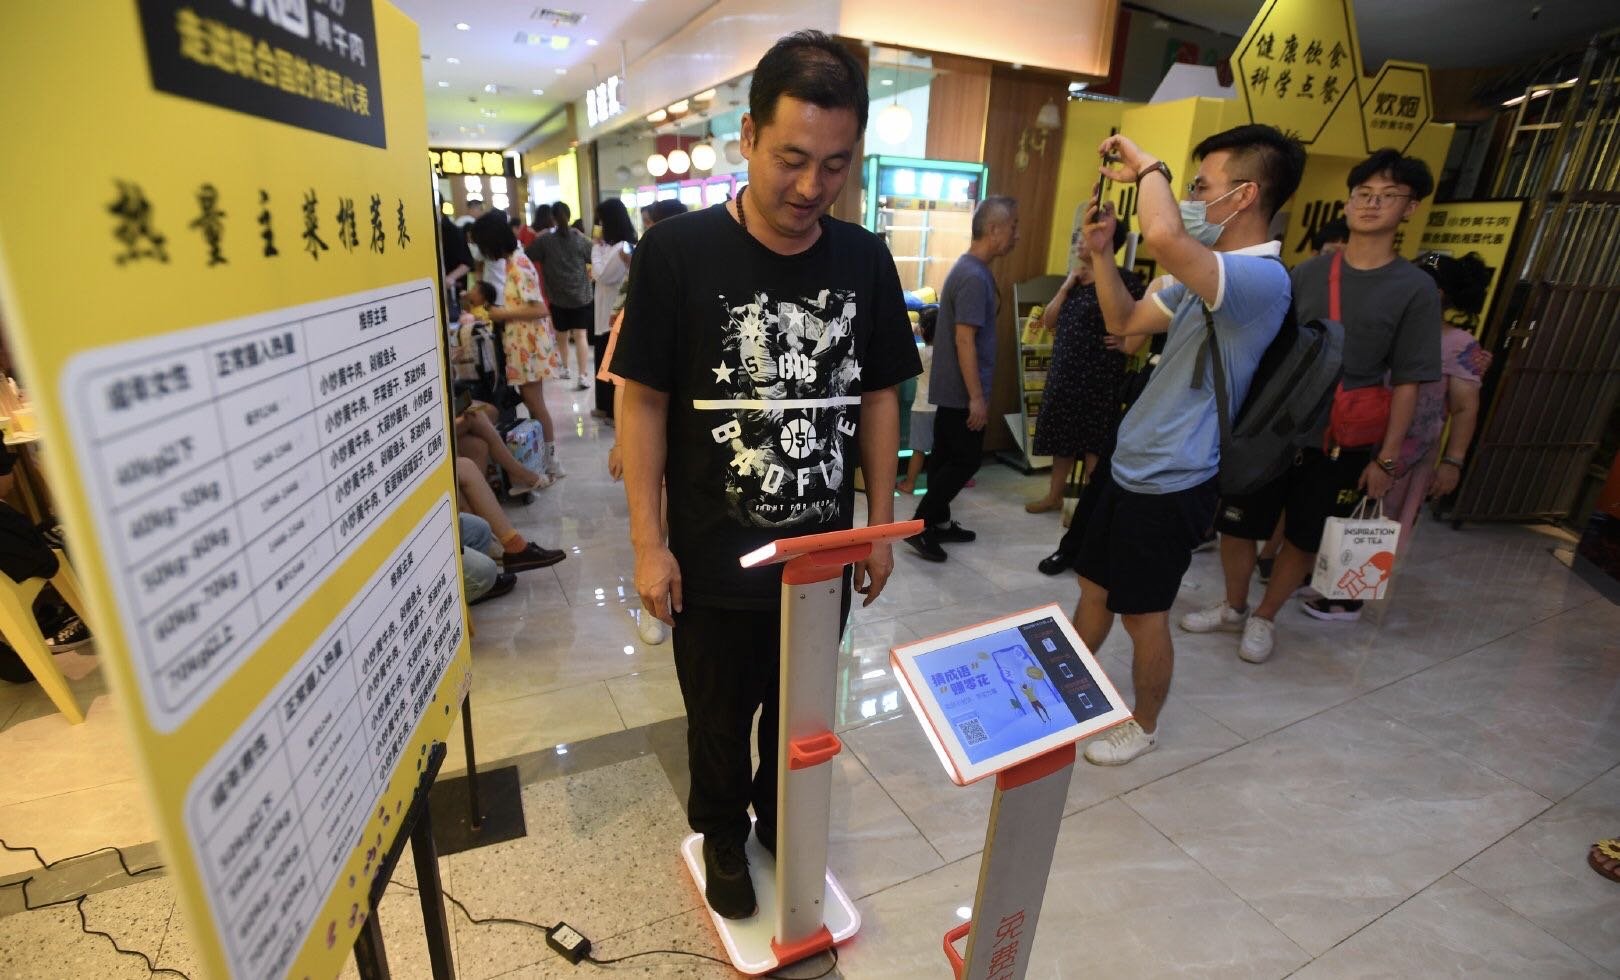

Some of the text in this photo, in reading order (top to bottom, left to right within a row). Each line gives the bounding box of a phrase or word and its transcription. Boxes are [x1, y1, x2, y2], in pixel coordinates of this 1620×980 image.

[1256, 32, 1347, 70] 健康饮食
[1250, 65, 1340, 105] 科学点餐
[358, 305, 388, 331] 推荐主菜
[214, 331, 296, 378] 正常摄入热量
[744, 355, 759, 375] 5
[794, 431, 806, 448] 5
[1344, 527, 1396, 536] INSPIRATION
[931, 664, 972, 688] 猜成语
[950, 673, 991, 697] 赚零花
